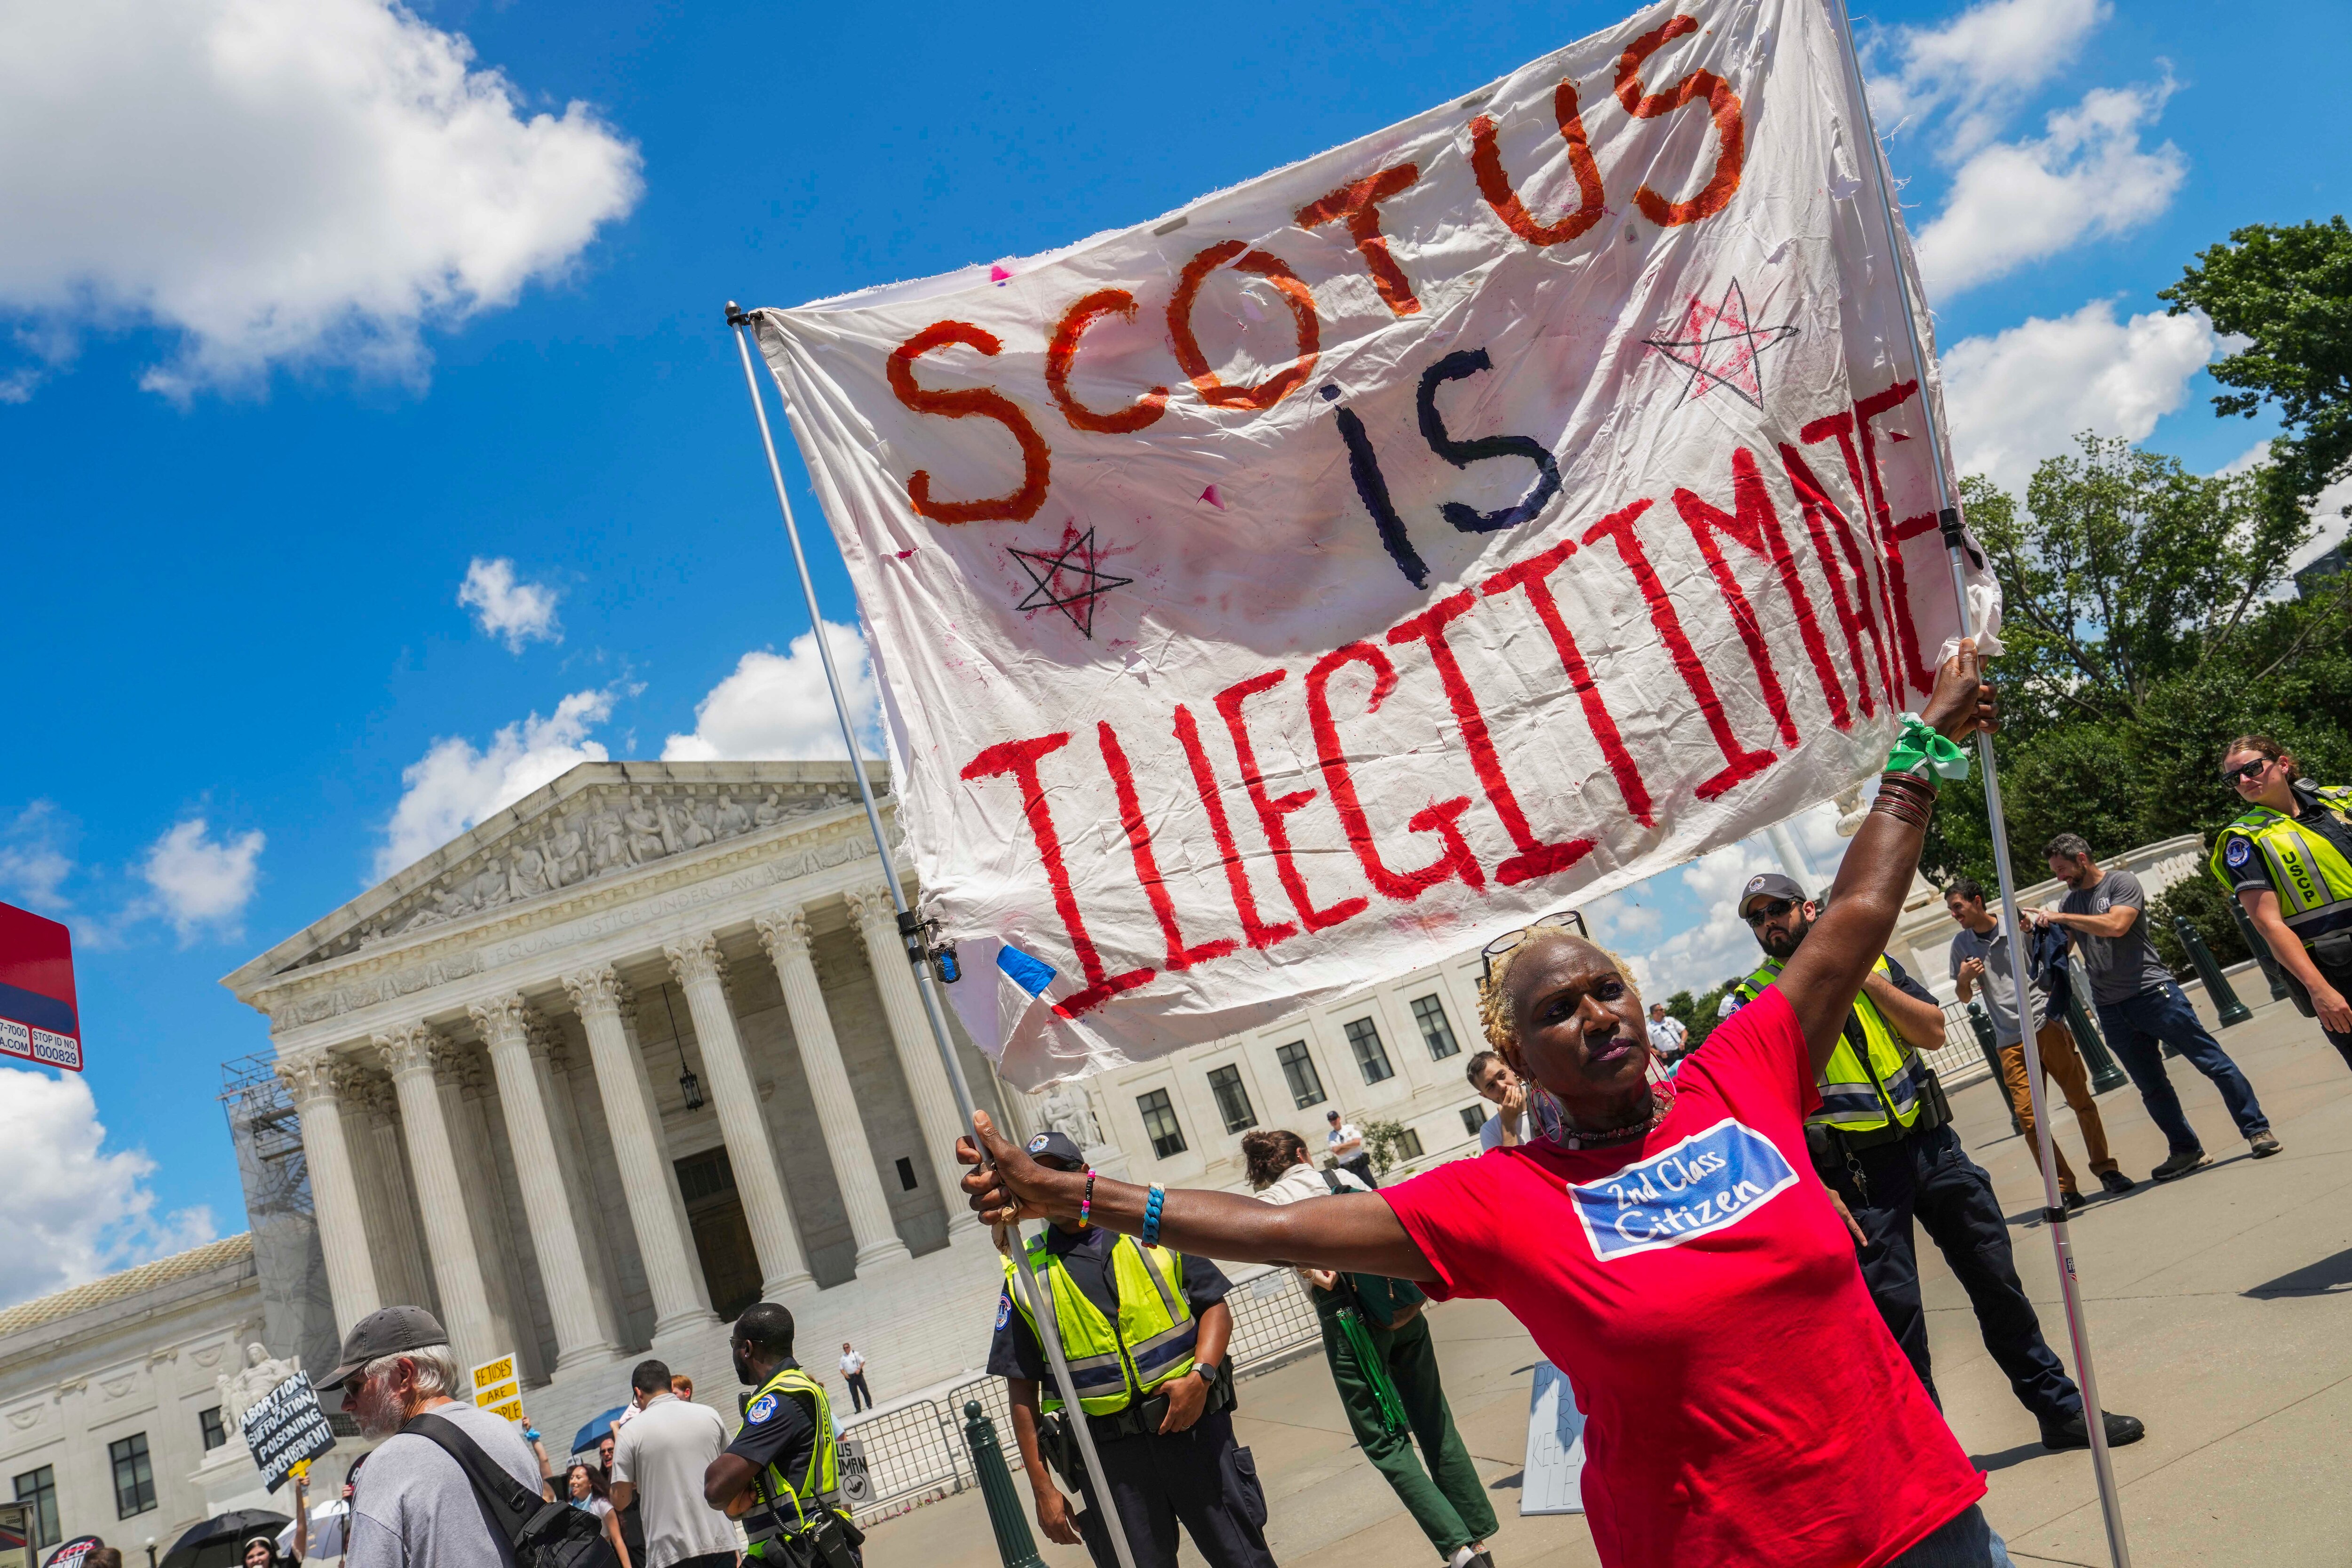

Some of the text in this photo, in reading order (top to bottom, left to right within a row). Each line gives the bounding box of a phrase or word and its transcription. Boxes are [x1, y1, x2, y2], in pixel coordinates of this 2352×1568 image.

[886, 15, 1744, 524] SCOTUS
[960, 379, 1938, 1019] ILLEGITIMATE
[2281, 851, 2314, 903] USCP
[496, 874, 755, 963] EQUAL JUSTICE UNDER LAW
[33, 1031, 77, 1050] STOP ID NO.
[34, 1043, 77, 1065] 1000829
[1607, 1151, 1727, 1211] 2nd Class
[1614, 1180, 1764, 1243] Citizen
[476, 1360, 512, 1387] FETUSES
[487, 1386, 507, 1403] ARE
[239, 1369, 307, 1431] ABORTION
[1532, 1427, 1574, 1472] KEEP
[1545, 1465, 1583, 1509] LE
